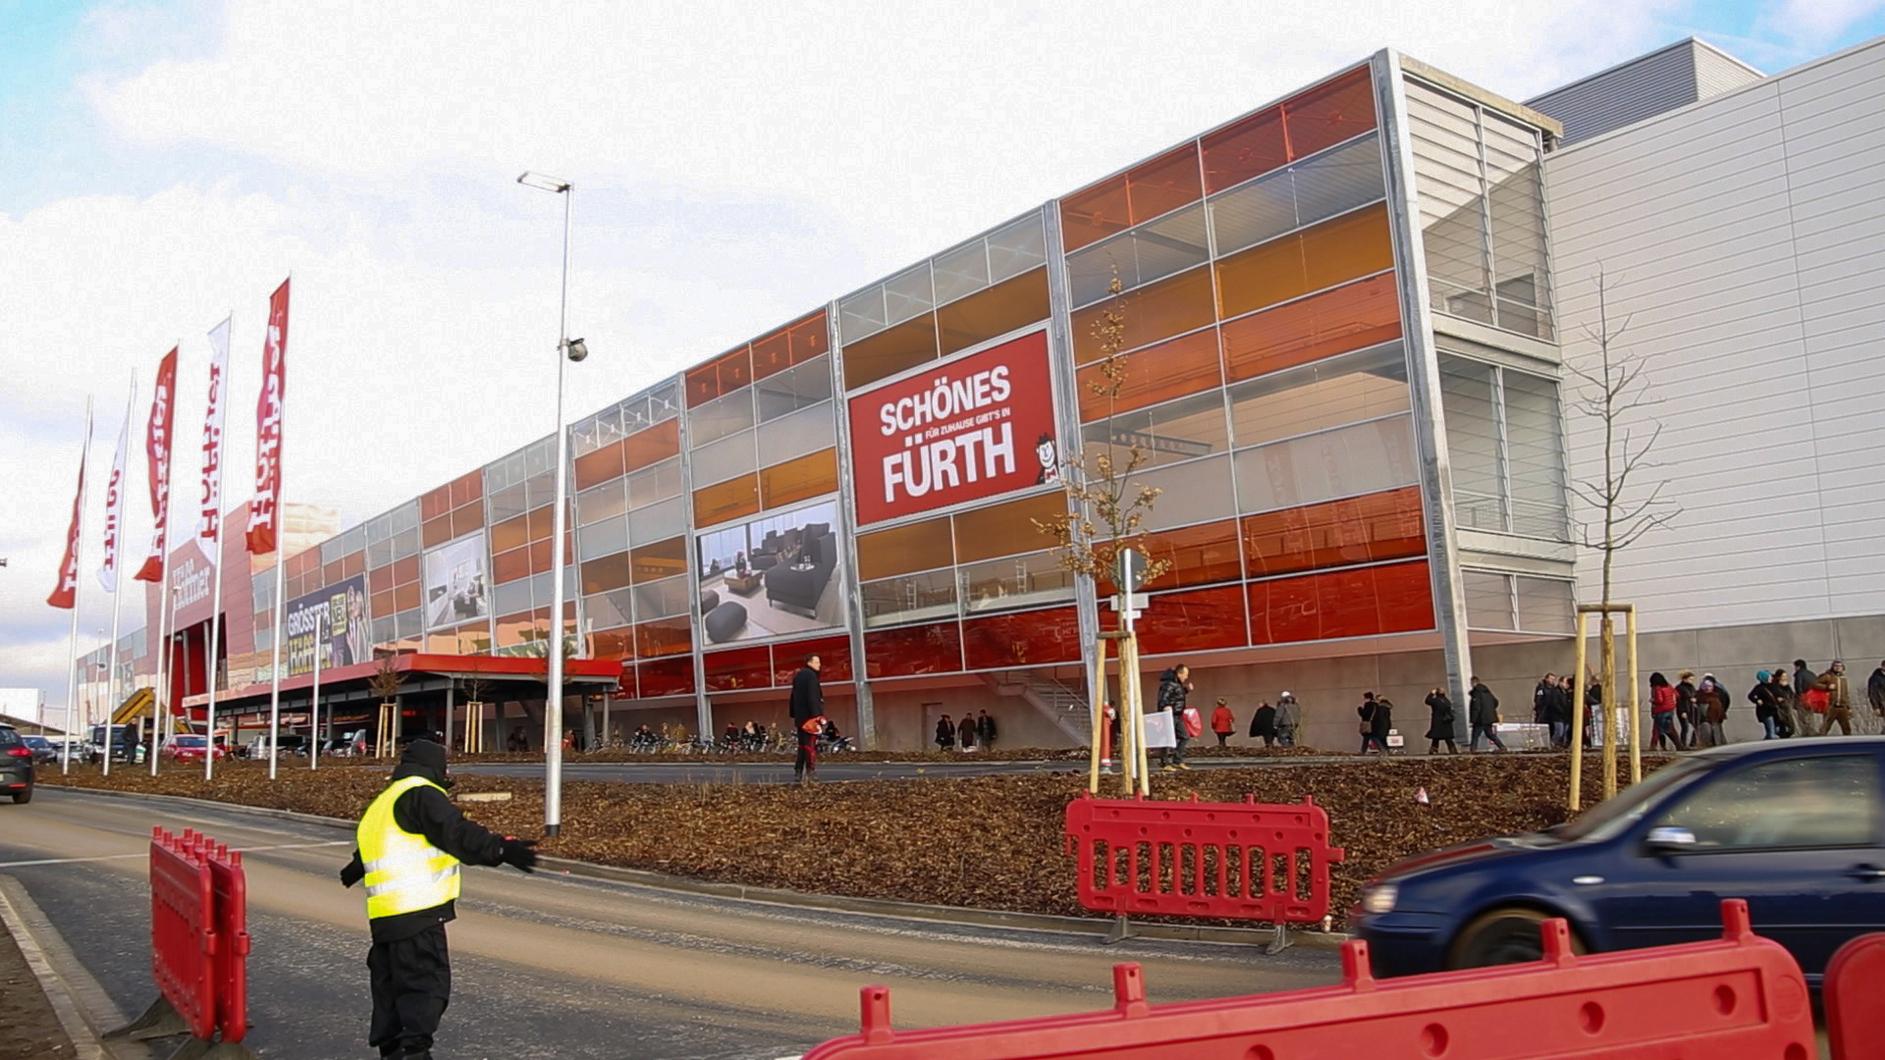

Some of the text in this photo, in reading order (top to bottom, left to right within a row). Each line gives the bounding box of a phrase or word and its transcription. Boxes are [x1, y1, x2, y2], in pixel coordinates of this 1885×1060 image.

[880, 365, 1011, 436] SCHÖNES
[925, 406, 1011, 440] FÜR ZUHAUSE GIBT'S IN
[883, 422, 1016, 503] FÜRTH
